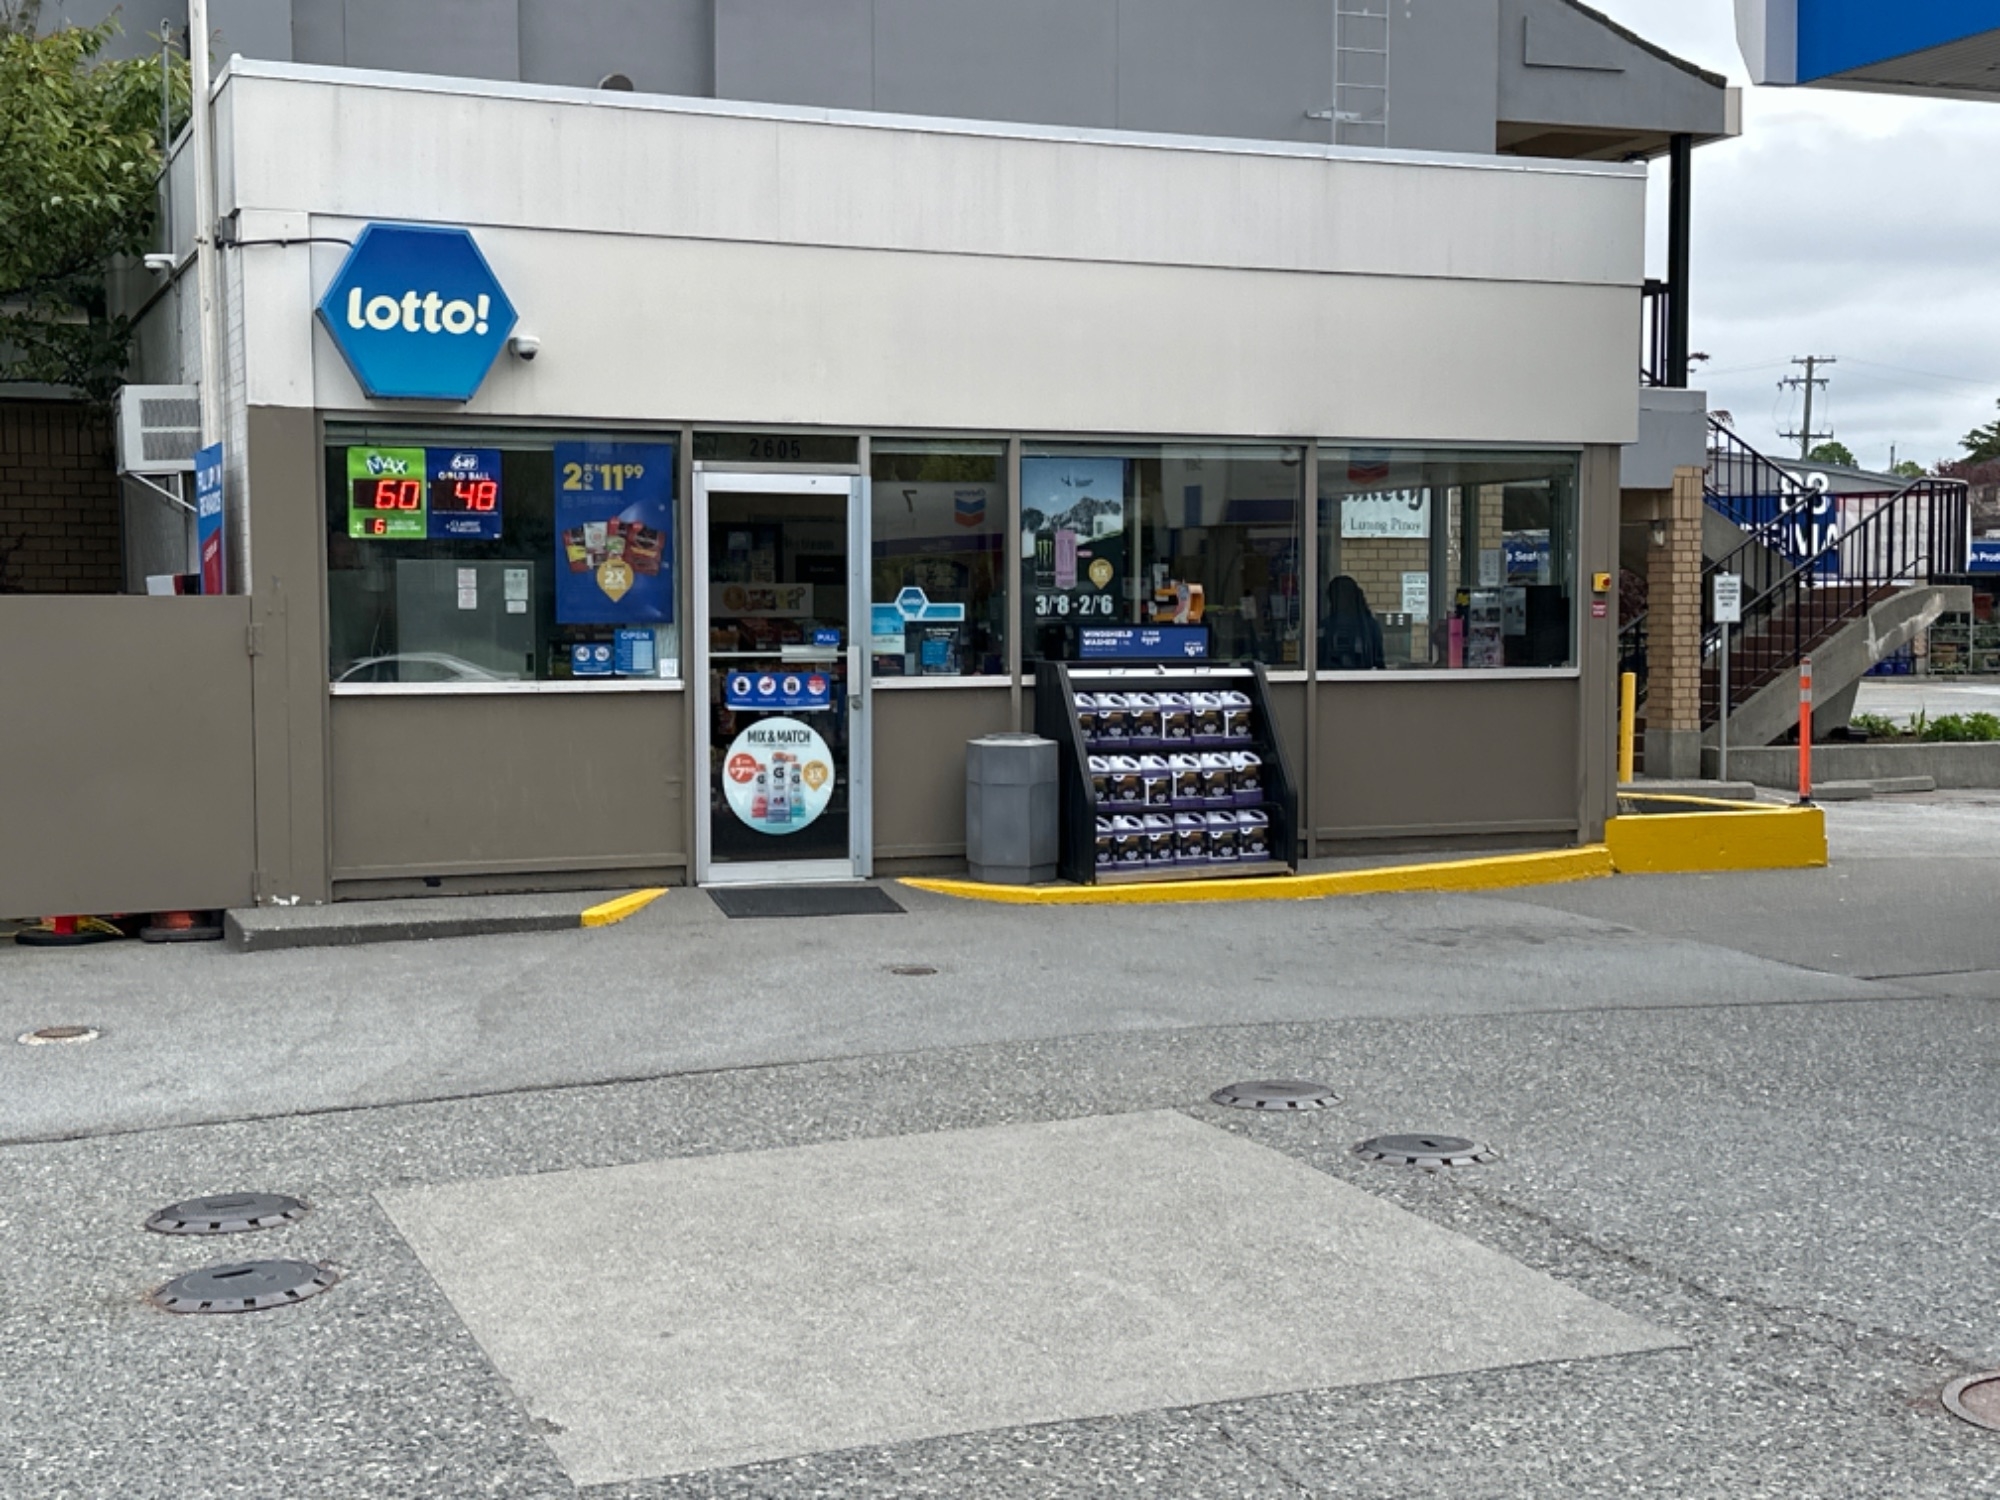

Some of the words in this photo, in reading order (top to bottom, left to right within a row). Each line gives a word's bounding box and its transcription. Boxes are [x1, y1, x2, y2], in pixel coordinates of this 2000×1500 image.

[347, 287, 490, 335] lotto!
[750, 438, 801, 459] 2605
[366, 456, 408, 475] MAX
[468, 471, 491, 481] BALL
[563, 462, 582, 491] 2
[375, 479, 420, 510] 60
[454, 481, 497, 511] 48
[374, 518, 385, 535] 6
[604, 571, 626, 585] 2X
[620, 631, 650, 640] OPEN
[816, 634, 837, 642] PULL
[1083, 630, 1133, 638] WINDSHIELD
[1083, 638, 1118, 646] WASHER
[747, 730, 766, 743] MIX
[767, 730, 776, 743] &
[777, 730, 811, 743] MATCH
